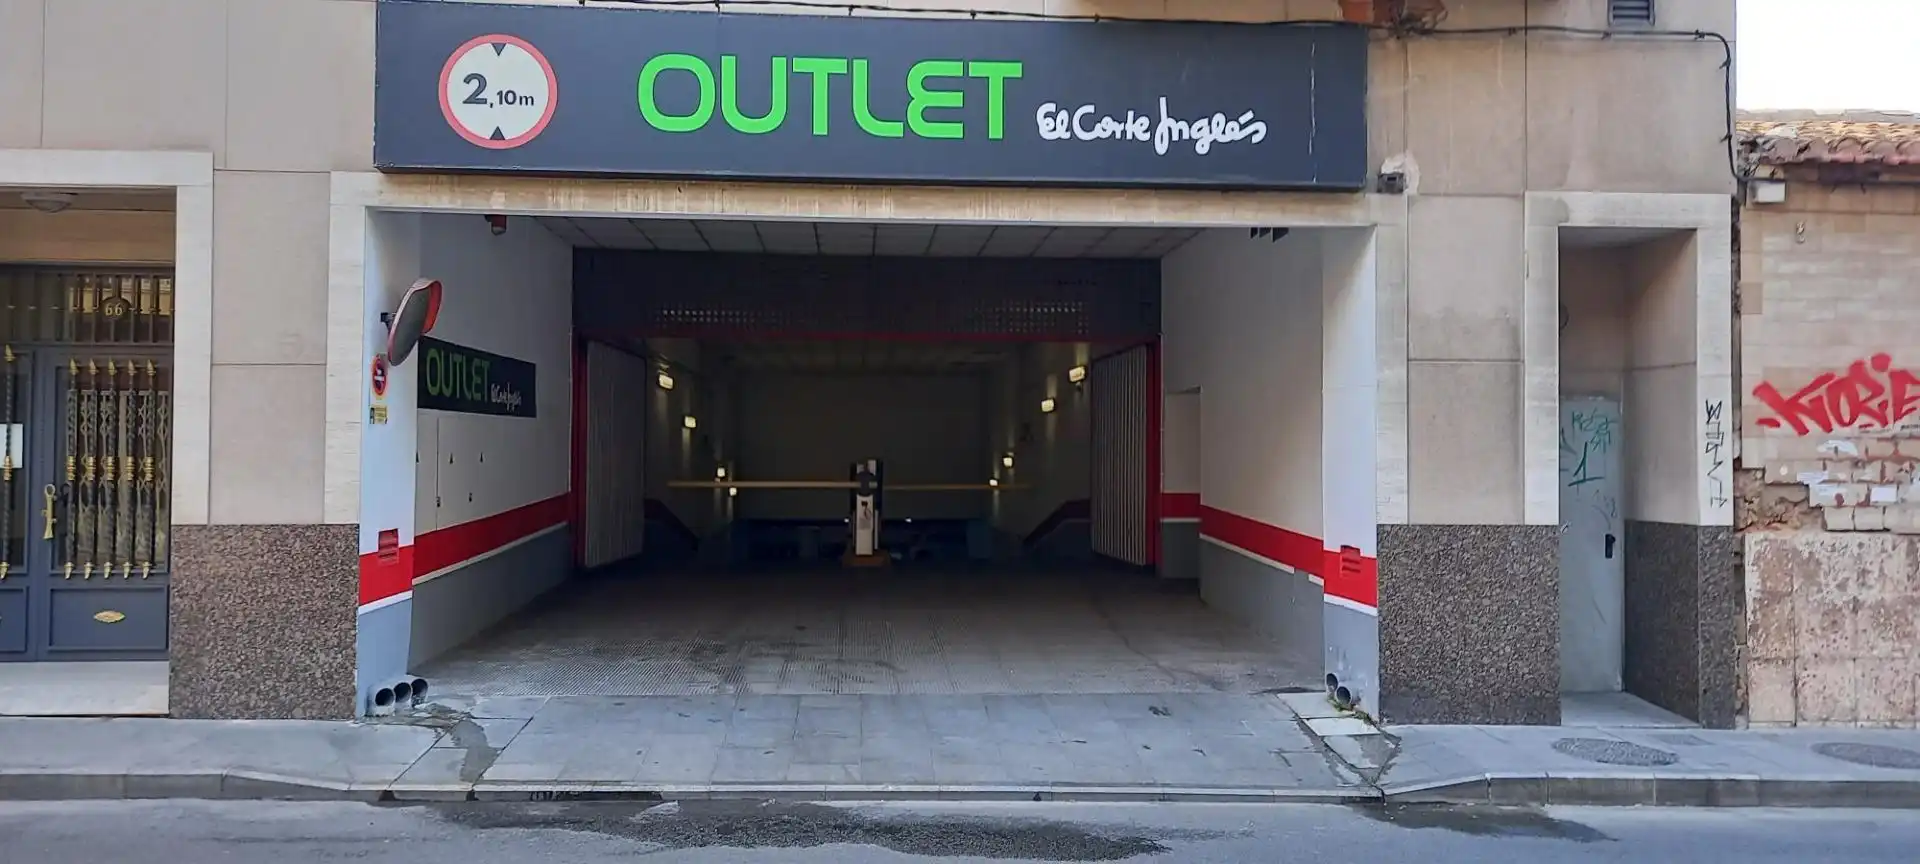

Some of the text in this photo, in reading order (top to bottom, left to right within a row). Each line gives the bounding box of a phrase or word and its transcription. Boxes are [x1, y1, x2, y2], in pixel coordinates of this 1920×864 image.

[638, 54, 1267, 155] OUTLET El Corte Inglés
[105, 303, 123, 316] 66
[426, 347, 490, 403] OUTLET
